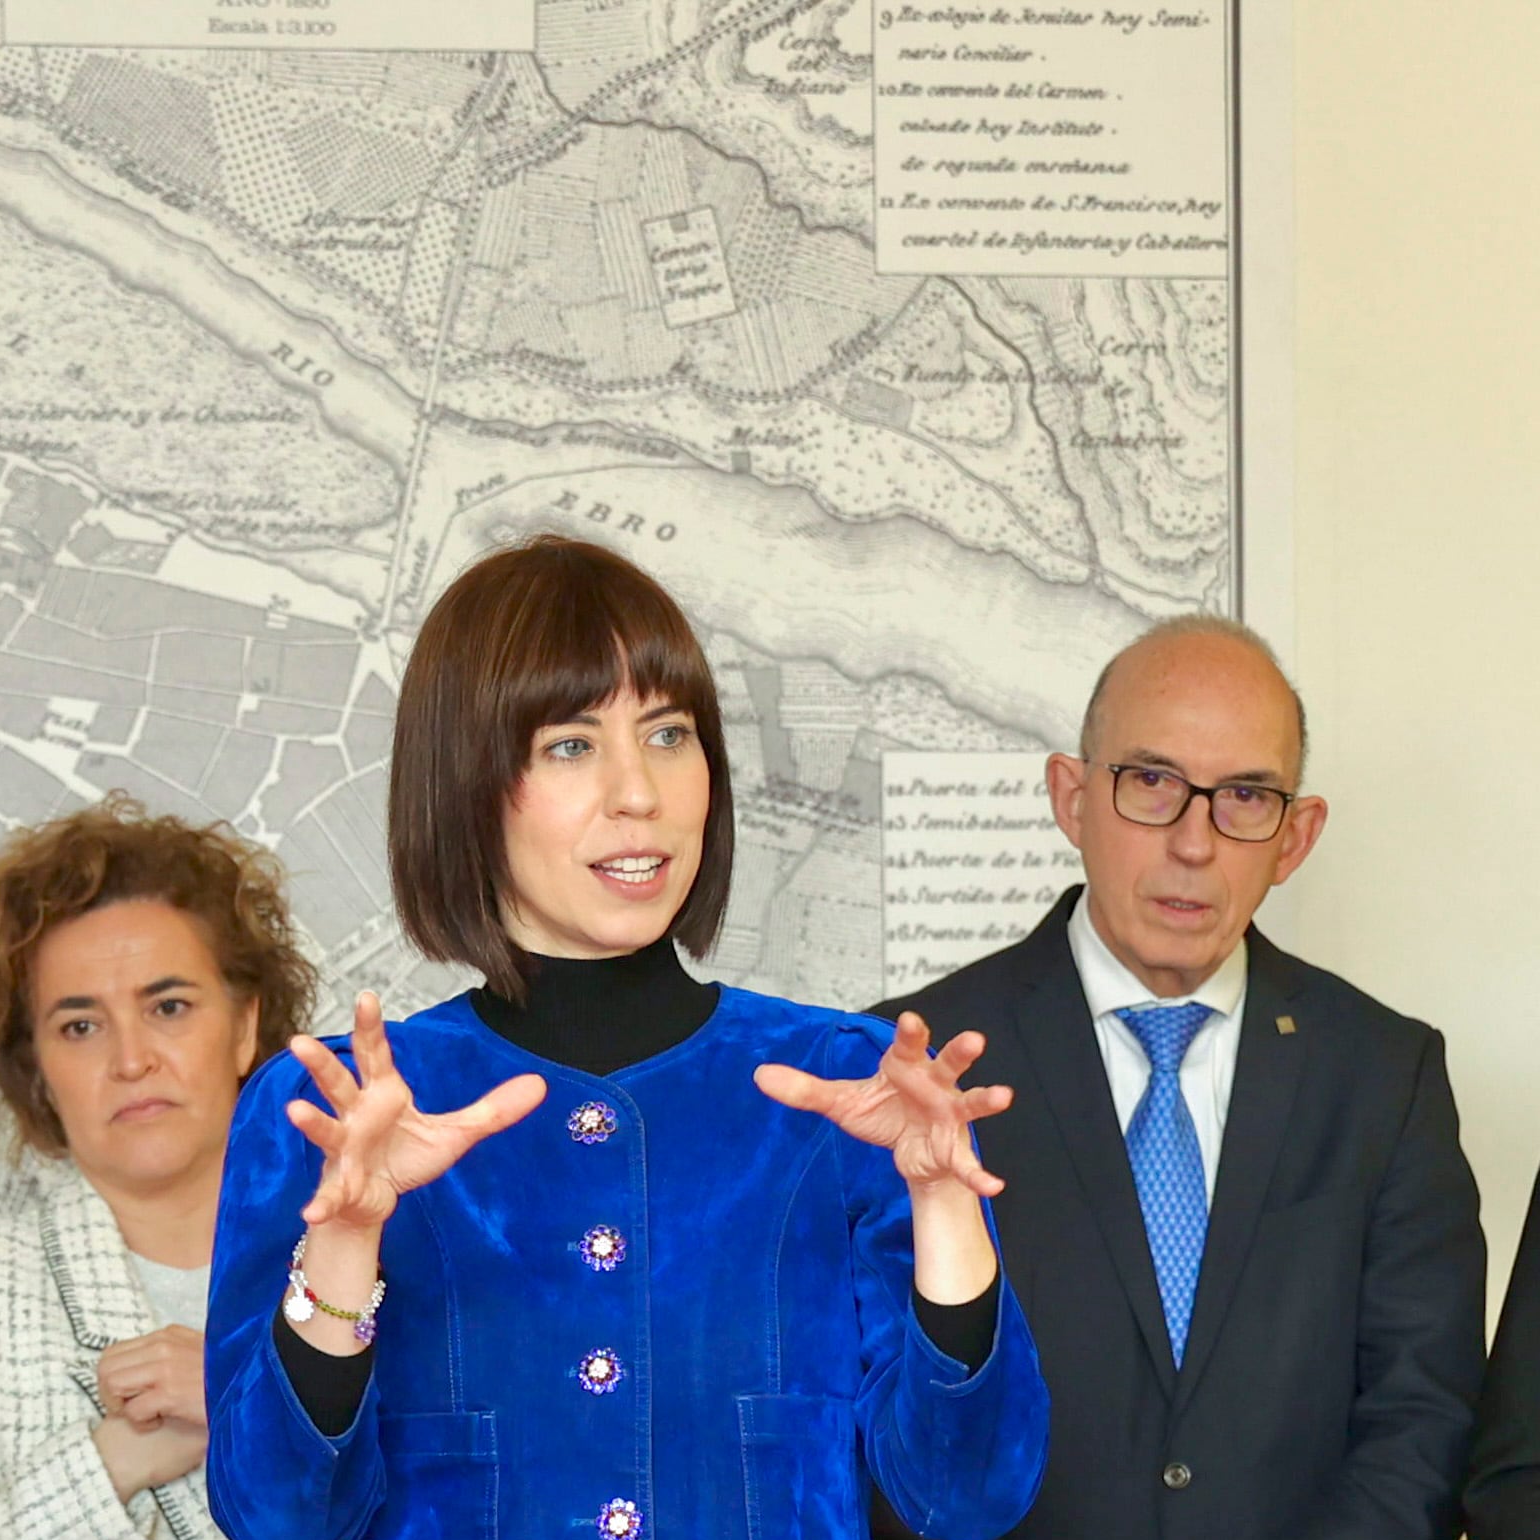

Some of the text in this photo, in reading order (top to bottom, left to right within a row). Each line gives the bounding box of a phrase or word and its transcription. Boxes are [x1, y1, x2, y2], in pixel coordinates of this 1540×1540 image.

[208, 18, 268, 34] Escala
[879, 11, 893, 30] 9
[989, 9, 1010, 25] de
[1101, 10, 1142, 35] hoy
[878, 85, 897, 97] 10
[1004, 83, 1033, 98] del
[900, 155, 926, 172] de
[1030, 194, 1056, 210] de
[982, 230, 1008, 248] de
[266, 340, 679, 544] RIO EBRO
[988, 778, 1025, 798] del
[990, 851, 1017, 869] de
[1021, 850, 1043, 869] la
[1001, 886, 1030, 904] de
[978, 922, 1003, 942] de
